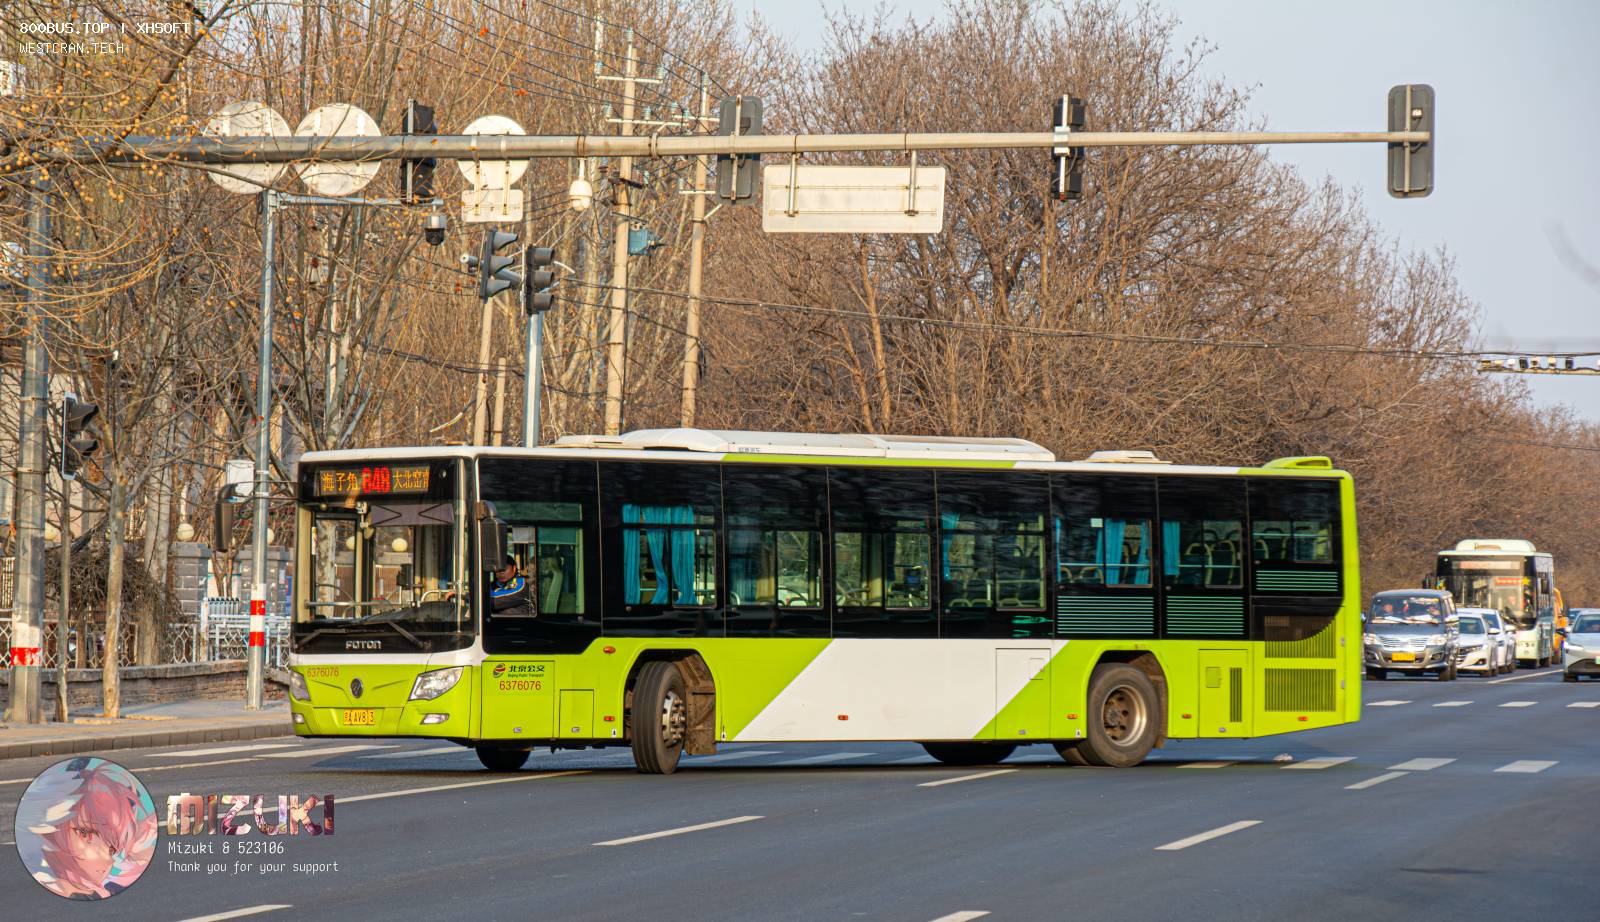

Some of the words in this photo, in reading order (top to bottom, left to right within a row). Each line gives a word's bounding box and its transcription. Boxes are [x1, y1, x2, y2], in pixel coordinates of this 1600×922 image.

[345, 640, 382, 650] FOTON
[306, 666, 340, 678] 6376076
[508, 664, 545, 672] 北京公交
[499, 680, 542, 691] 6376076
